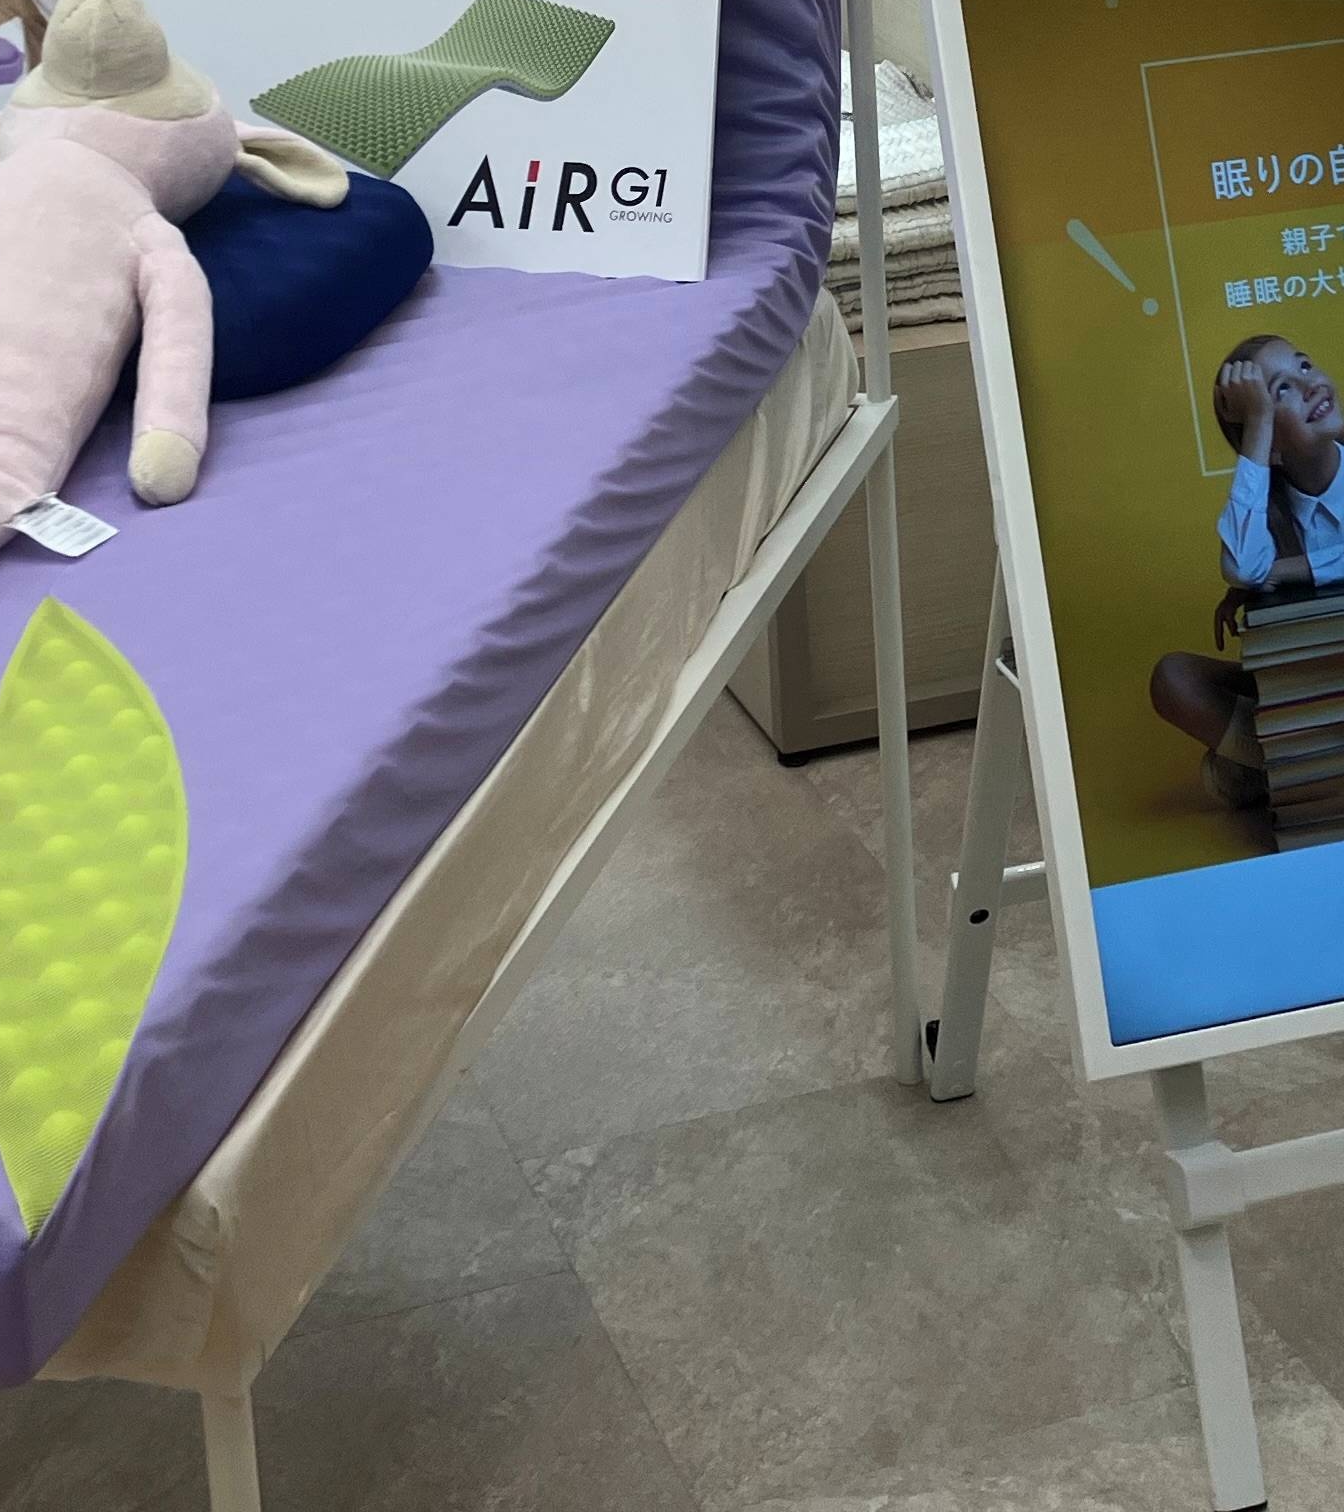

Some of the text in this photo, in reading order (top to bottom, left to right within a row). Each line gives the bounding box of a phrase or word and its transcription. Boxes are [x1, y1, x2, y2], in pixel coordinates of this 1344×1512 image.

[446, 154, 668, 233] AiR G1
[608, 209, 674, 224] GROWING
